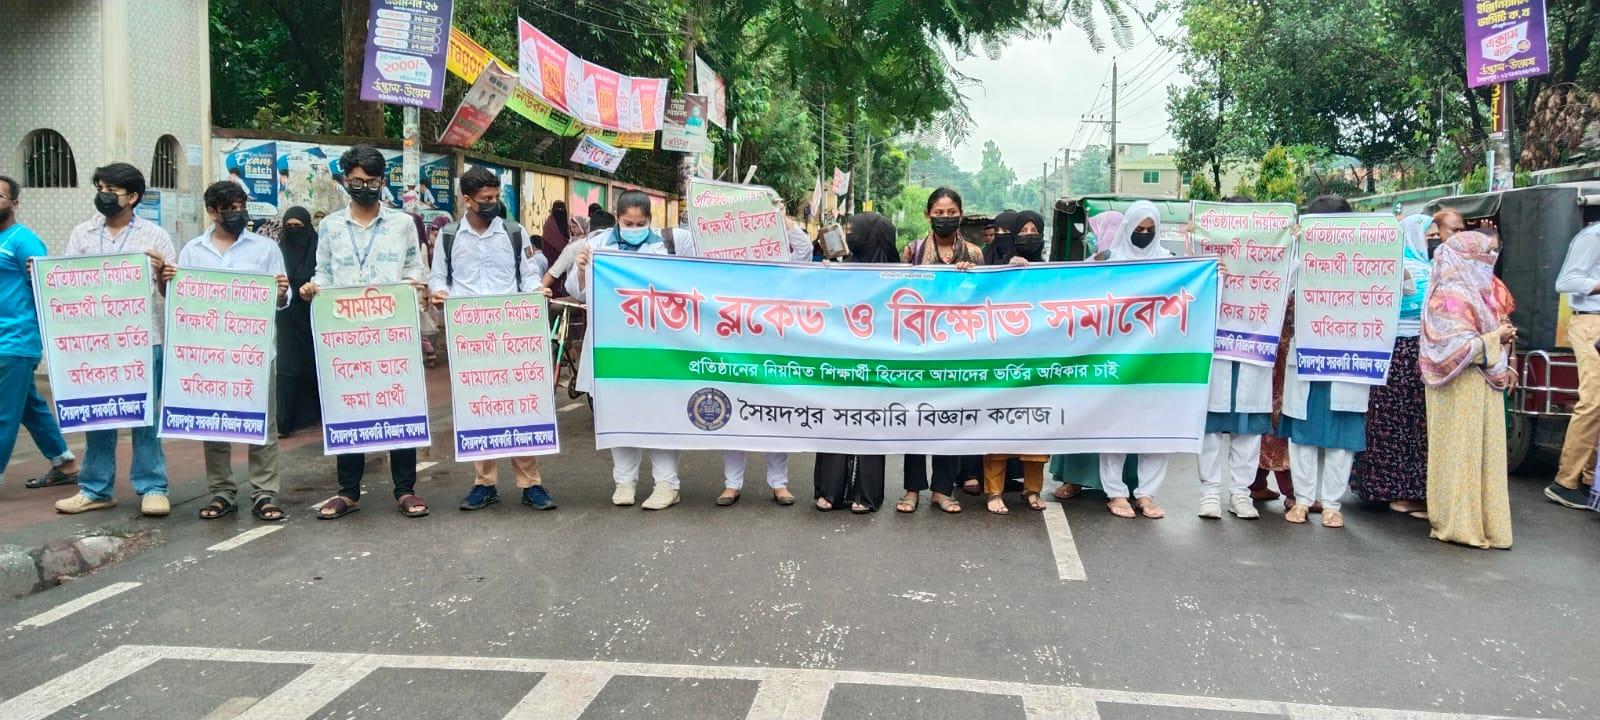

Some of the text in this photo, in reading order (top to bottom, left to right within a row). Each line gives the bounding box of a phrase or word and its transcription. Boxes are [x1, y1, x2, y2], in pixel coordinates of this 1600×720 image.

[246, 166, 272, 175] Batch
[697, 210, 777, 237] শিক্ষার্থী হিসেবে
[1200, 208, 1249, 232] প্রতিষ্ঠানের
[1252, 210, 1289, 232] নিয়মিত
[1304, 220, 1397, 245] প্রতিষ্ঠানের নিয়মিত
[750, 238, 781, 258] ভর্তির
[1246, 239, 1286, 264] হিসেবে
[46, 260, 143, 289] প্রতিষ্ঠানের নিয়মিত
[1303, 251, 1396, 277] শিক্ষার্থী হিসেবে
[176, 273, 270, 303] প্রতিষ্ঠানের নিয়মিত
[1249, 271, 1280, 292] ভর্তির
[49, 294, 145, 320] শিক্ষার্থী হিসেবে
[335, 287, 396, 320] সাময়িক
[1303, 284, 1394, 308] আমাদের ভর্তির
[174, 307, 268, 336] শিক্ষার্থী হিসেবে
[453, 299, 541, 326] প্রতিষ্ঠানের নিয়মিত
[616, 285, 1195, 345] রাস্তা ব্লকেড ও বিক্ষোভ সমাবেশ
[1249, 303, 1269, 324] চাই
[54, 325, 149, 353] আমাদের ভর্তির
[320, 325, 413, 348] যানজটের জন্য
[1311, 315, 1384, 341] অধিকার চাই
[173, 344, 265, 367] আমাদের ভর্তির
[455, 332, 544, 357] শিক্ষার্থী হিসেবে
[68, 360, 146, 385] অধিকার চাই
[332, 356, 409, 380] বিশেষ ভাবে
[457, 360, 545, 388] আমাদের ভর্তির
[688, 357, 1120, 384] প্রতিষ্ঠানের নিয়মিত শিক্ষার্থী হিসেবে আমাদের ভর্তির অধিকার চাই
[180, 373, 255, 401] অধিকার চাই
[342, 383, 406, 410] ক্ষমা প্রার্থী
[469, 394, 540, 416] অধিকার চাই
[737, 397, 826, 430] সৈয়দপুর
[832, 402, 910, 427] সরকারি
[916, 402, 981, 427] বিজ্ঞান
[987, 406, 1053, 426] কলেজ
